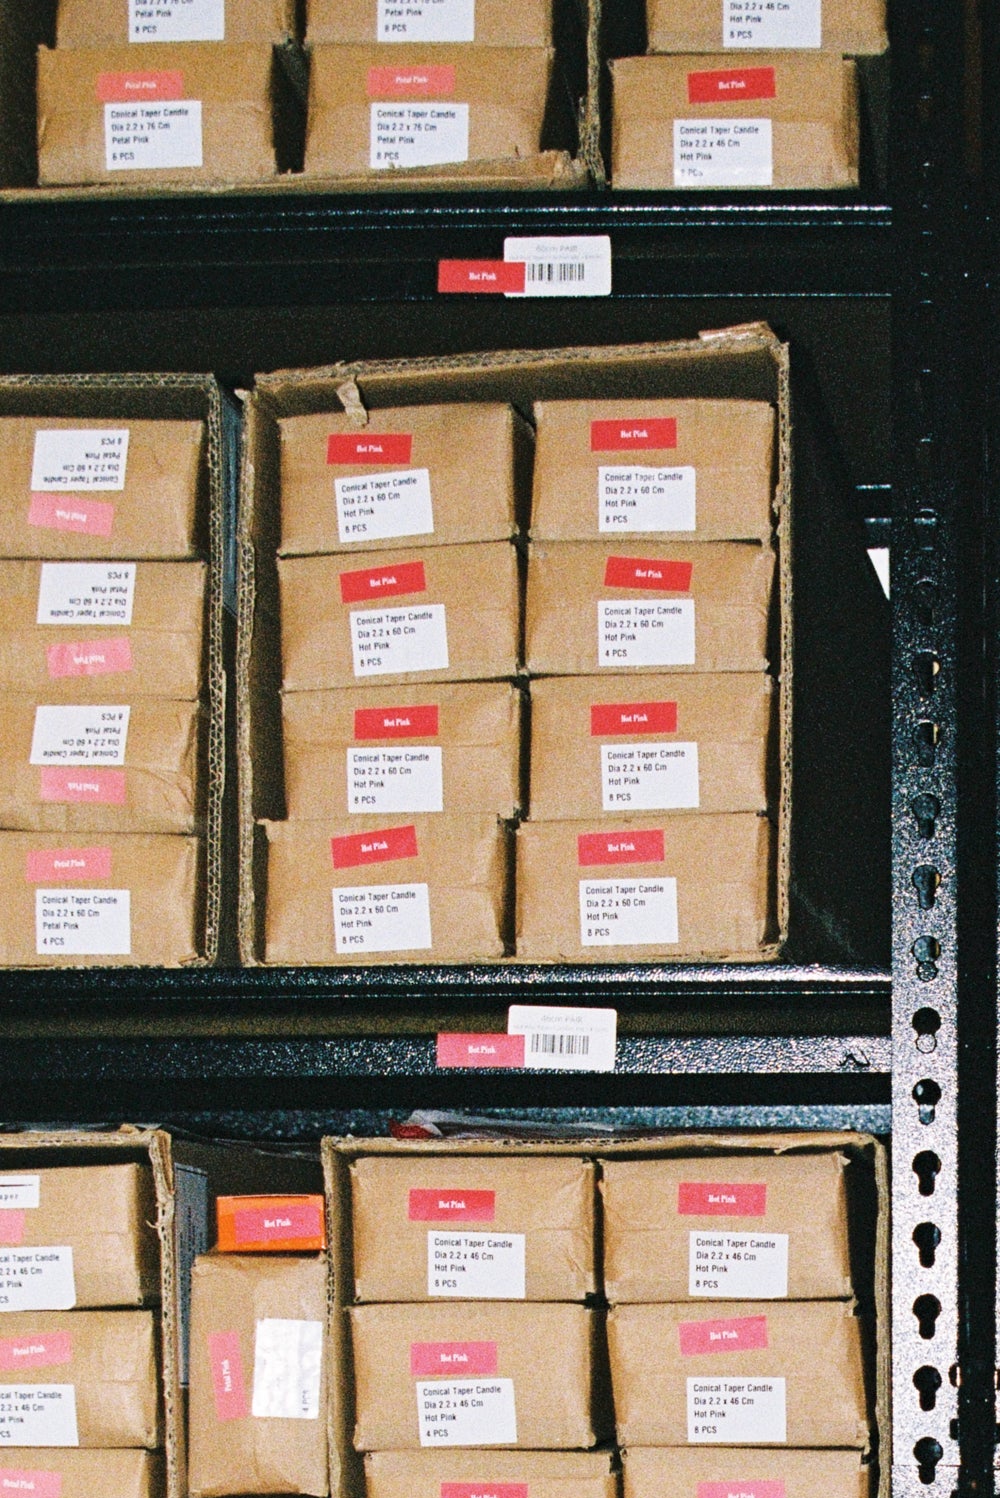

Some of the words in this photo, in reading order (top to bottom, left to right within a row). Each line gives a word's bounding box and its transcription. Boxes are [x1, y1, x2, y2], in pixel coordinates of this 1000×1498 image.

[718, 81, 730, 90] Hot
[730, 80, 746, 89] Pink
[679, 126, 707, 135] Conical
[710, 126, 731, 135] Taper
[733, 125, 759, 134] Candle
[680, 139, 694, 148] Dia
[716, 139, 726, 147] 46
[727, 139, 740, 147] Cm
[680, 153, 694, 161] Hot
[696, 152, 712, 160] Pink
[468, 272, 481, 281] Hot
[481, 272, 497, 281] Pink
[620, 430, 632, 439] Hot
[632, 429, 648, 438] Pink
[356, 444, 368, 453] Hot
[368, 444, 383, 453] Pink
[604, 473, 632, 482] Conical
[634, 472, 655, 482] Taper
[657, 472, 683, 481] Candle
[341, 483, 368, 493] Conical
[370, 481, 391, 490] Taper
[392, 477, 417, 487] Candle
[605, 486, 618, 495] Dia
[640, 486, 650, 494] 60
[652, 486, 665, 494] Cm
[342, 497, 355, 505] Dia
[376, 492, 387, 502] 60
[387, 492, 401, 500] Cm
[605, 499, 618, 508] Hot
[620, 499, 637, 507] Pink
[343, 509, 357, 518] Hot
[358, 507, 375, 516] Pink
[612, 515, 628, 524] PCS
[352, 523, 367, 532] PCS
[468, 1045, 480, 1054] Hot
[480, 1045, 496, 1054] Pink
[438, 1200, 450, 1209] Hot
[450, 1200, 466, 1209] Pink
[434, 1237, 462, 1247] Conical
[464, 1238, 485, 1248] Taper
[487, 1239, 513, 1249] Candle
[434, 1250, 447, 1259] Dia
[470, 1252, 479, 1261] 46
[481, 1252, 494, 1261] Cm
[434, 1264, 448, 1272] Hot
[450, 1263, 466, 1272] Pink
[441, 1279, 457, 1288] PCS
